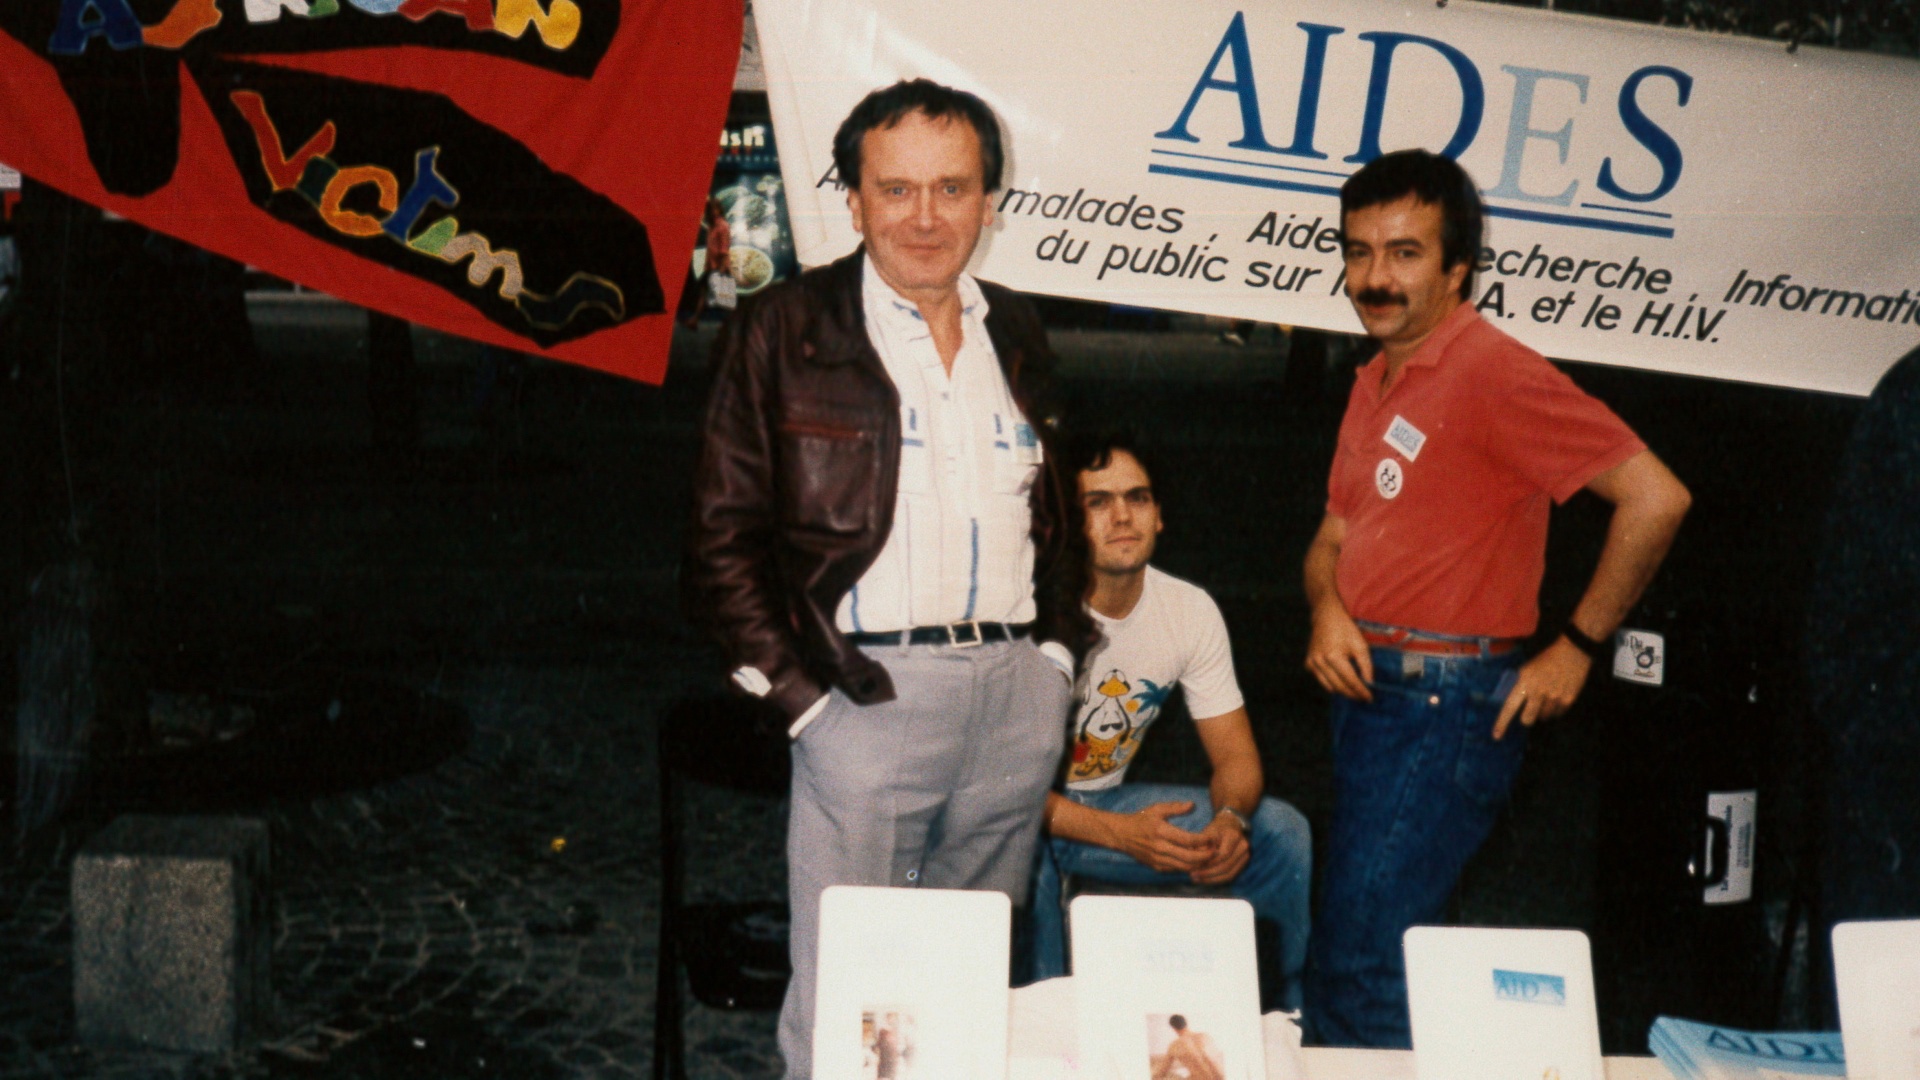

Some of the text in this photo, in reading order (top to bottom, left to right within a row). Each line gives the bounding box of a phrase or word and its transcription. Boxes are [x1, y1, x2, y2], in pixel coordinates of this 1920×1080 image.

[1154, 10, 1694, 207] AIDES
[998, 188, 1185, 233] malades
[1246, 211, 1341, 253] Aide
[1477, 244, 1673, 295] echerche
[1036, 229, 1090, 264] du
[1097, 241, 1229, 281] public
[1244, 260, 1323, 292] sur
[1530, 291, 1576, 324] et
[1581, 294, 1622, 330] le
[1496, 975, 1566, 1003] AIDS
